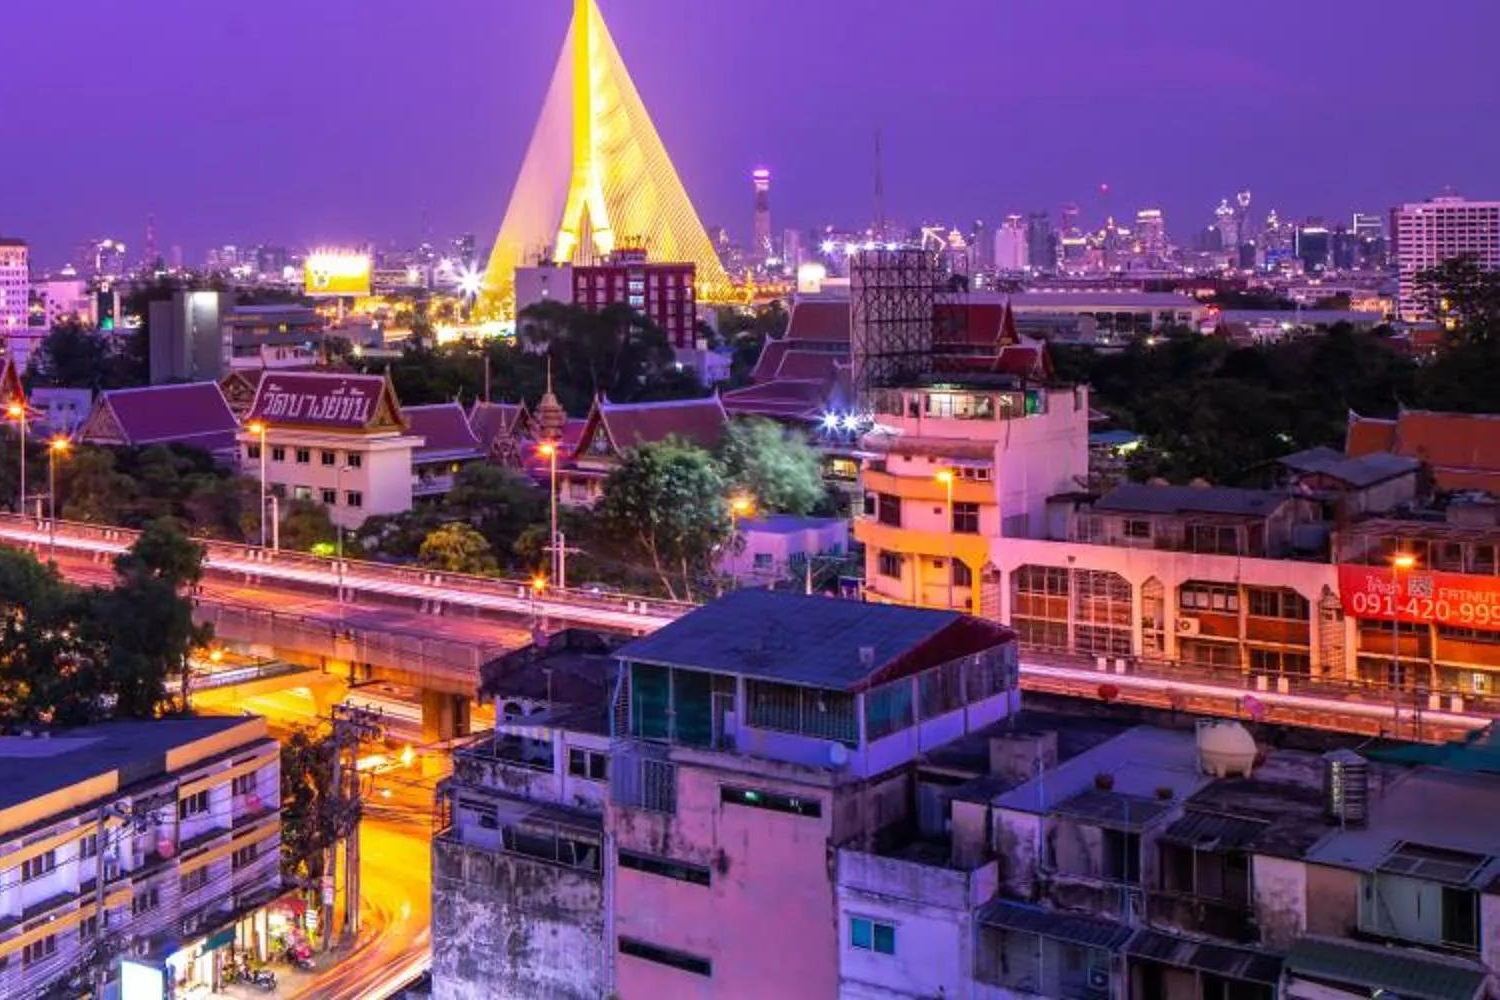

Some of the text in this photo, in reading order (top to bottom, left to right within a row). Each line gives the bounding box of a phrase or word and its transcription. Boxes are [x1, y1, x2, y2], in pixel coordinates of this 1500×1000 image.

[263, 380, 371, 420] วัดบางยี่ขัน
